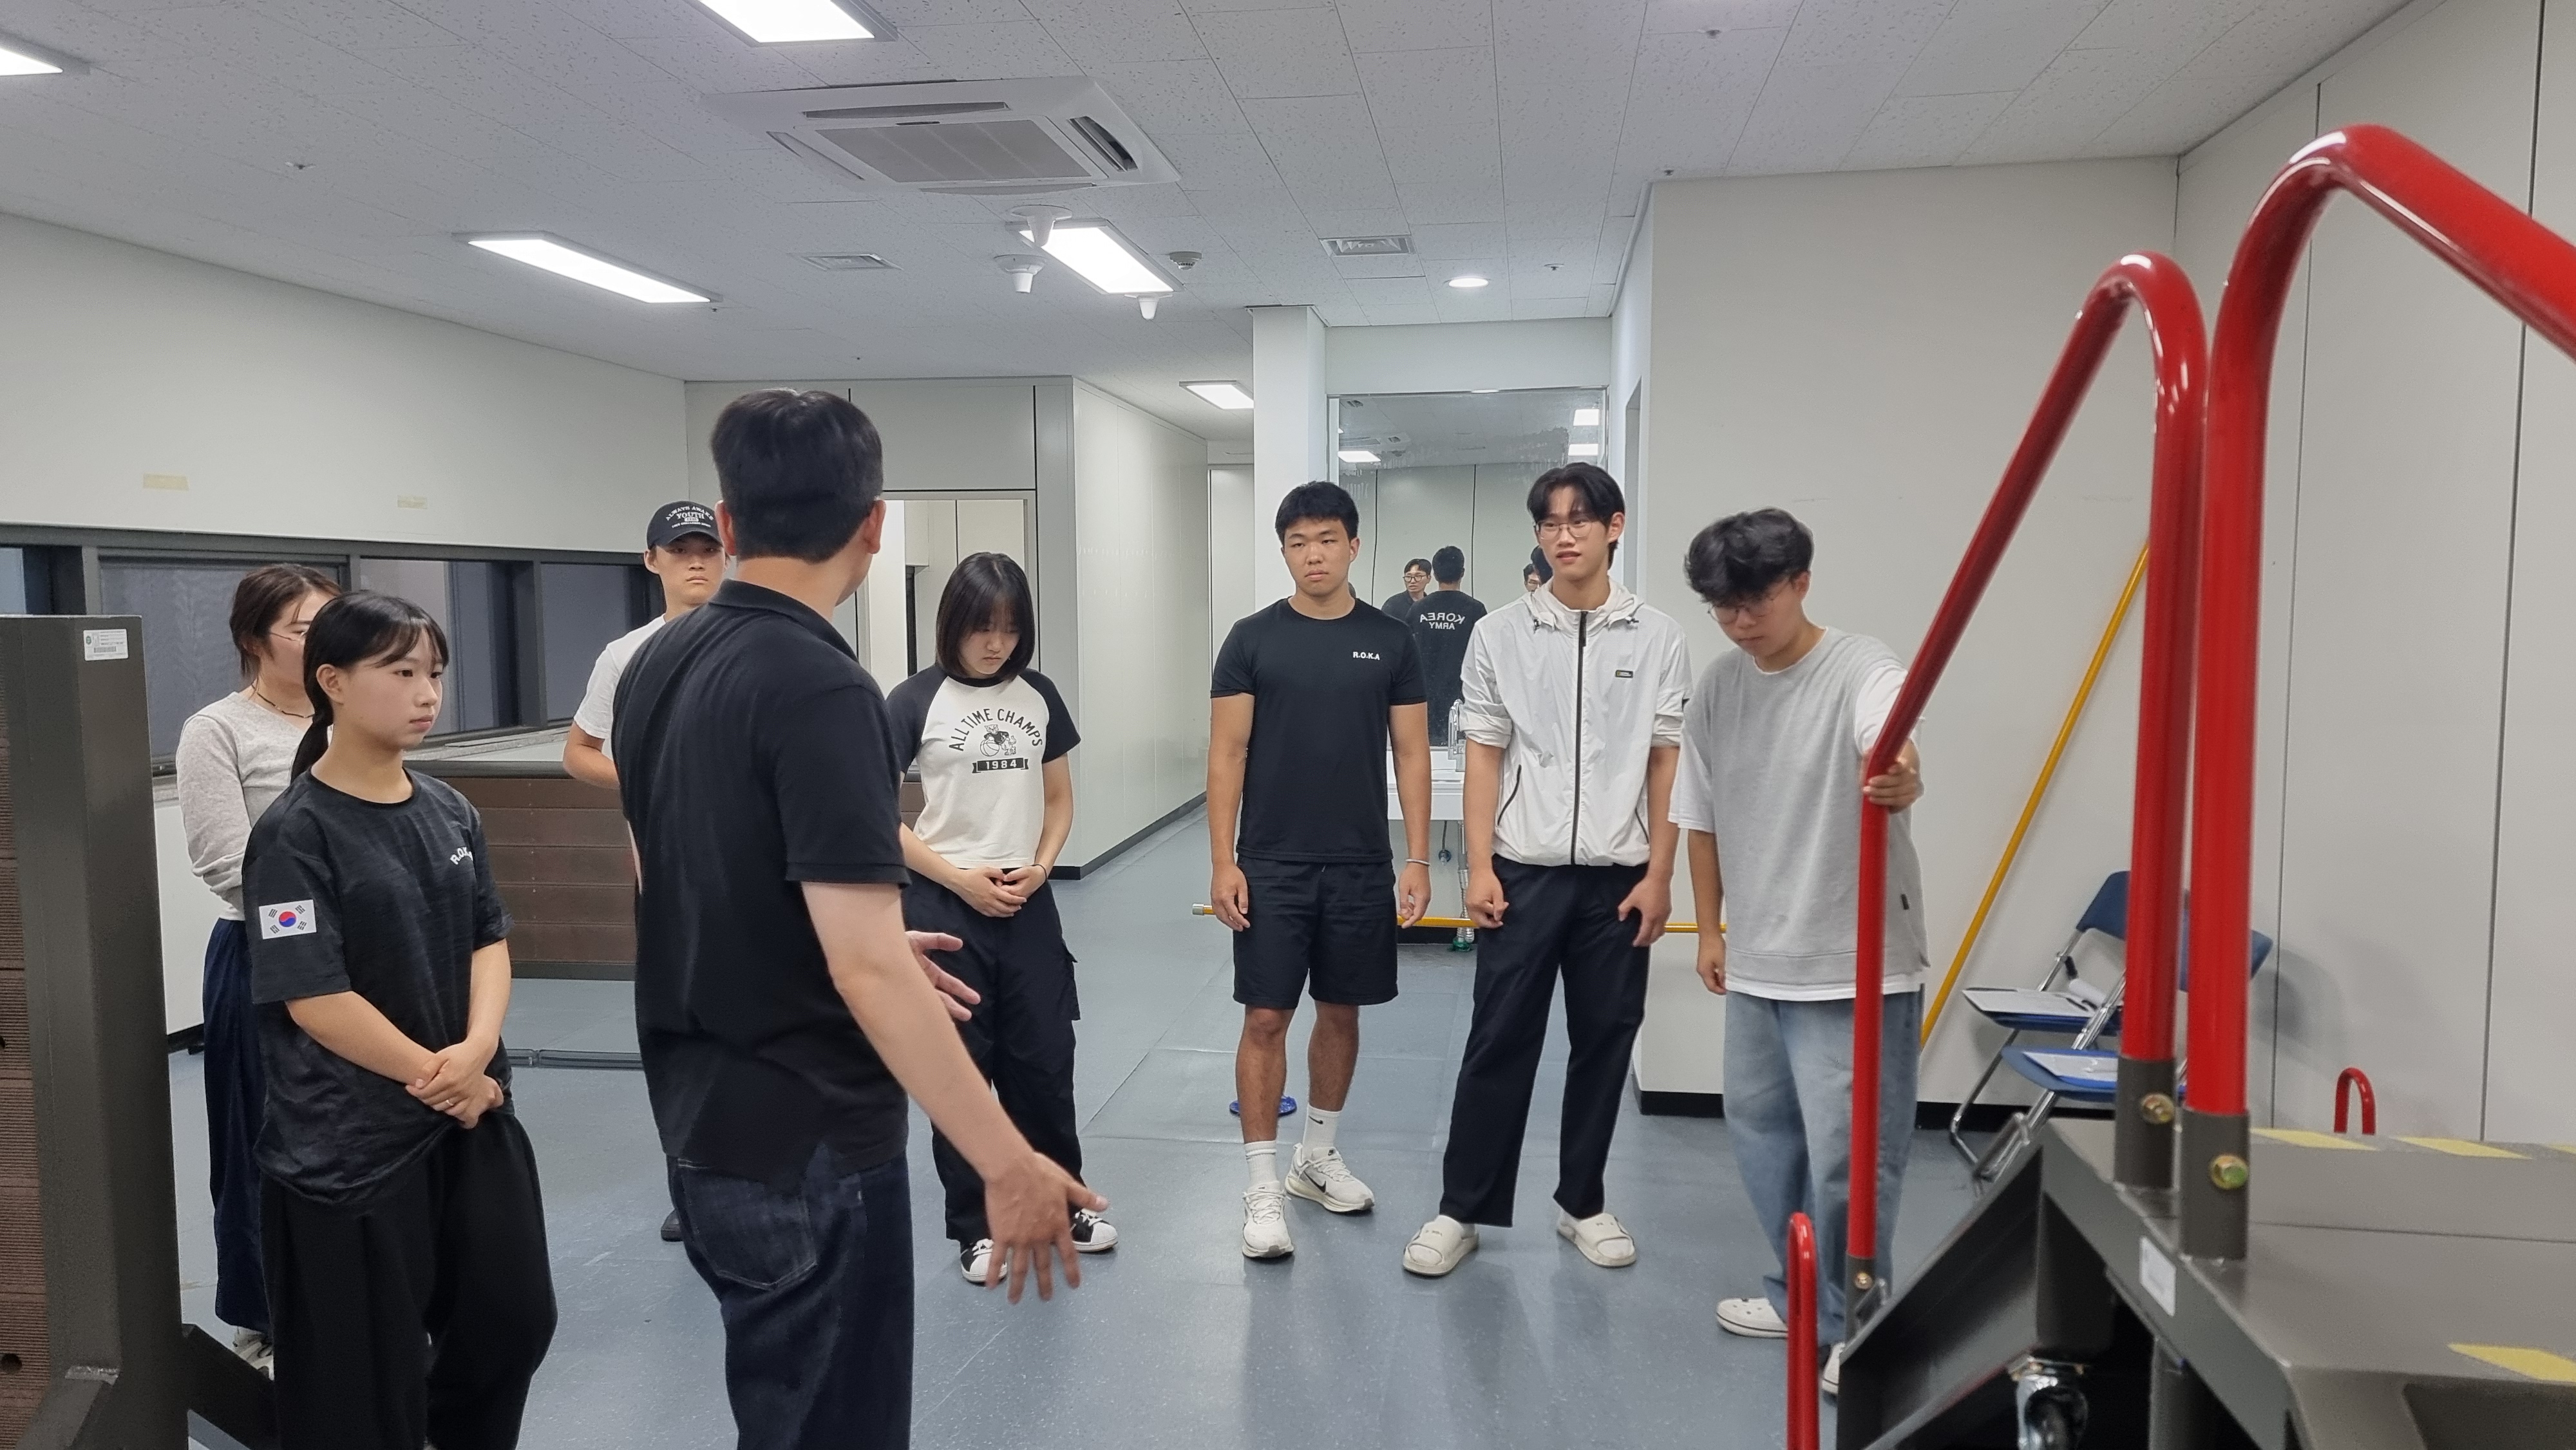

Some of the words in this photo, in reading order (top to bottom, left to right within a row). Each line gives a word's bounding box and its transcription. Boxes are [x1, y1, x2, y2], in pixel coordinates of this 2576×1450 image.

[666, 505, 690, 520] ALWAYS
[949, 728, 969, 751] ALL
[961, 709, 993, 728] TIME
[998, 709, 1043, 746] CHAMPS
[986, 760, 1016, 769] 1984
